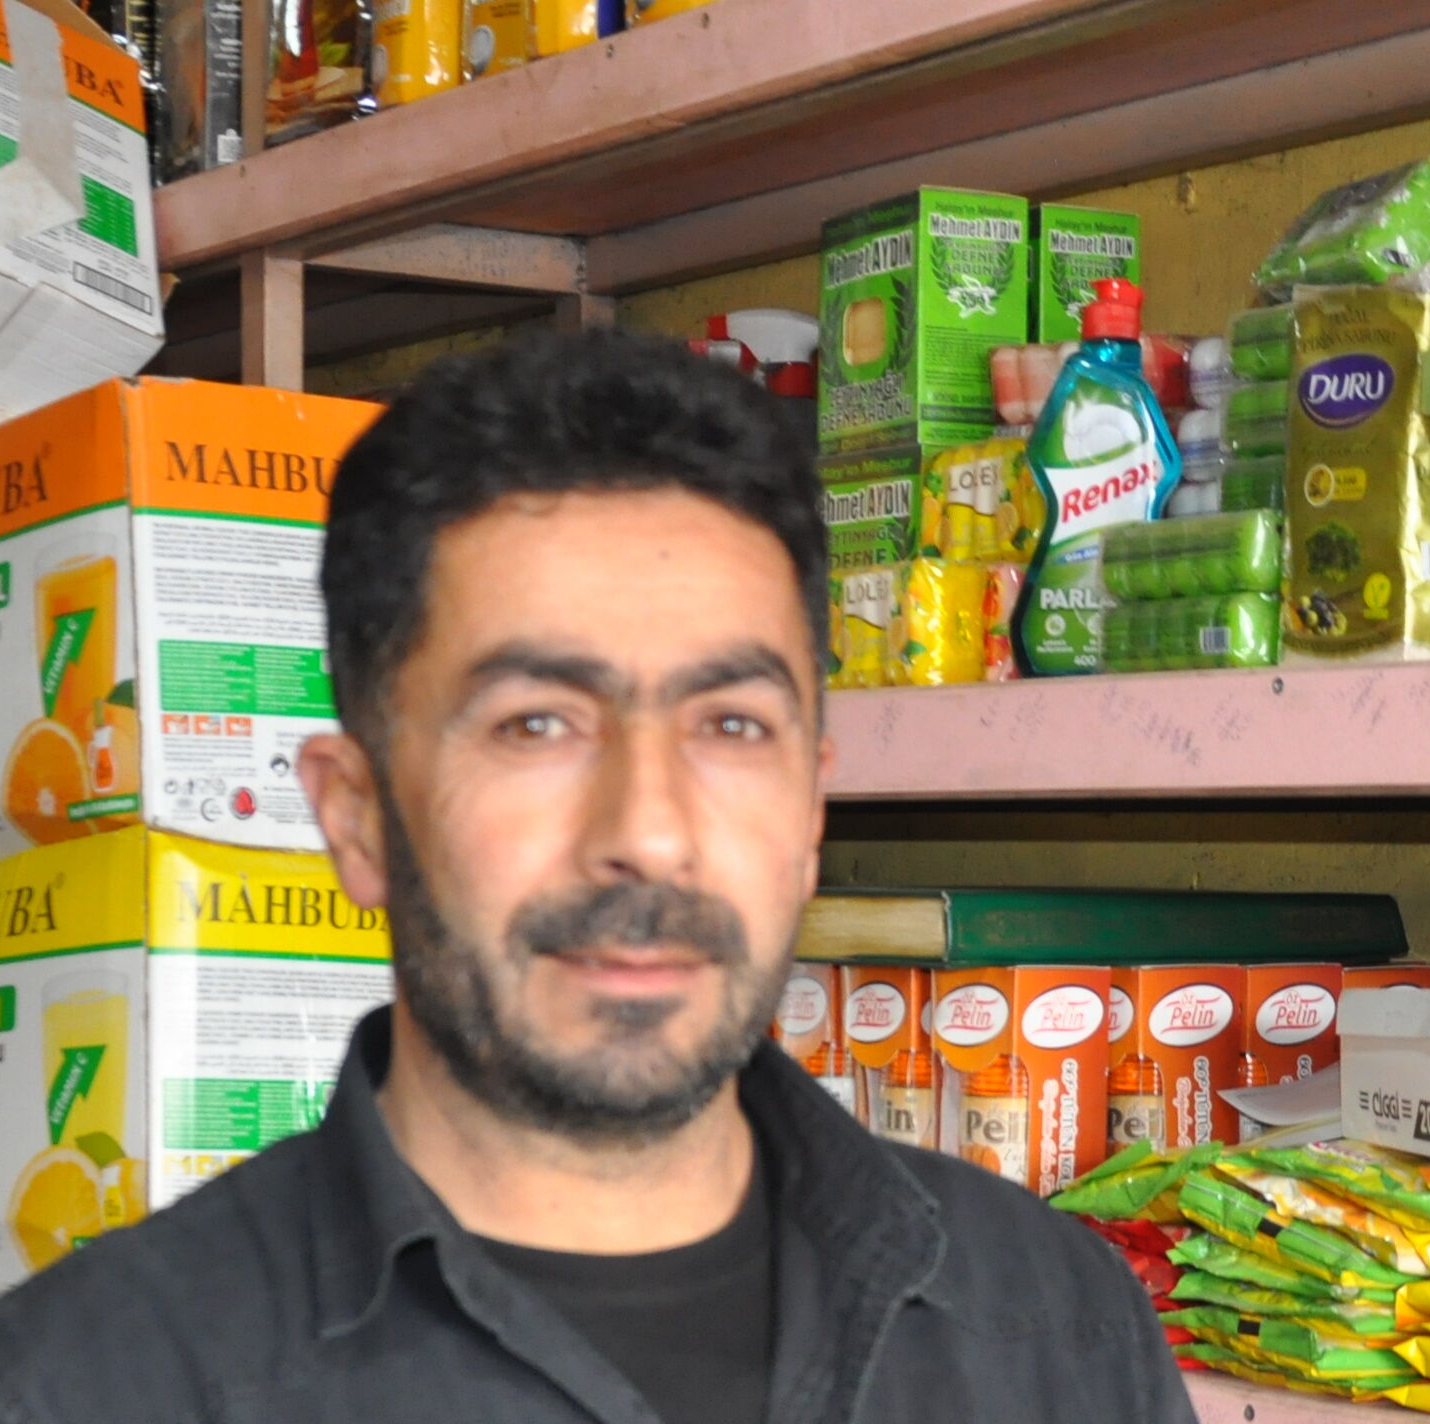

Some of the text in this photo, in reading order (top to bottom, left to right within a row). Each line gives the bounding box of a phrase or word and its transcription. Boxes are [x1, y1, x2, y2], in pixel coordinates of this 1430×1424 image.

[984, 219, 1021, 241] AYDIN
[1098, 235, 1135, 257] AYDIN
[1308, 371, 1384, 402] DURU
[1062, 460, 1157, 522] Renax
[856, 1004, 891, 1024] Pelin
[952, 1003, 992, 1027] Pelin
[1040, 1006, 1084, 1029] Pelin
[1171, 1003, 1214, 1025] Pelin
[1275, 1003, 1318, 1025] Pelin
